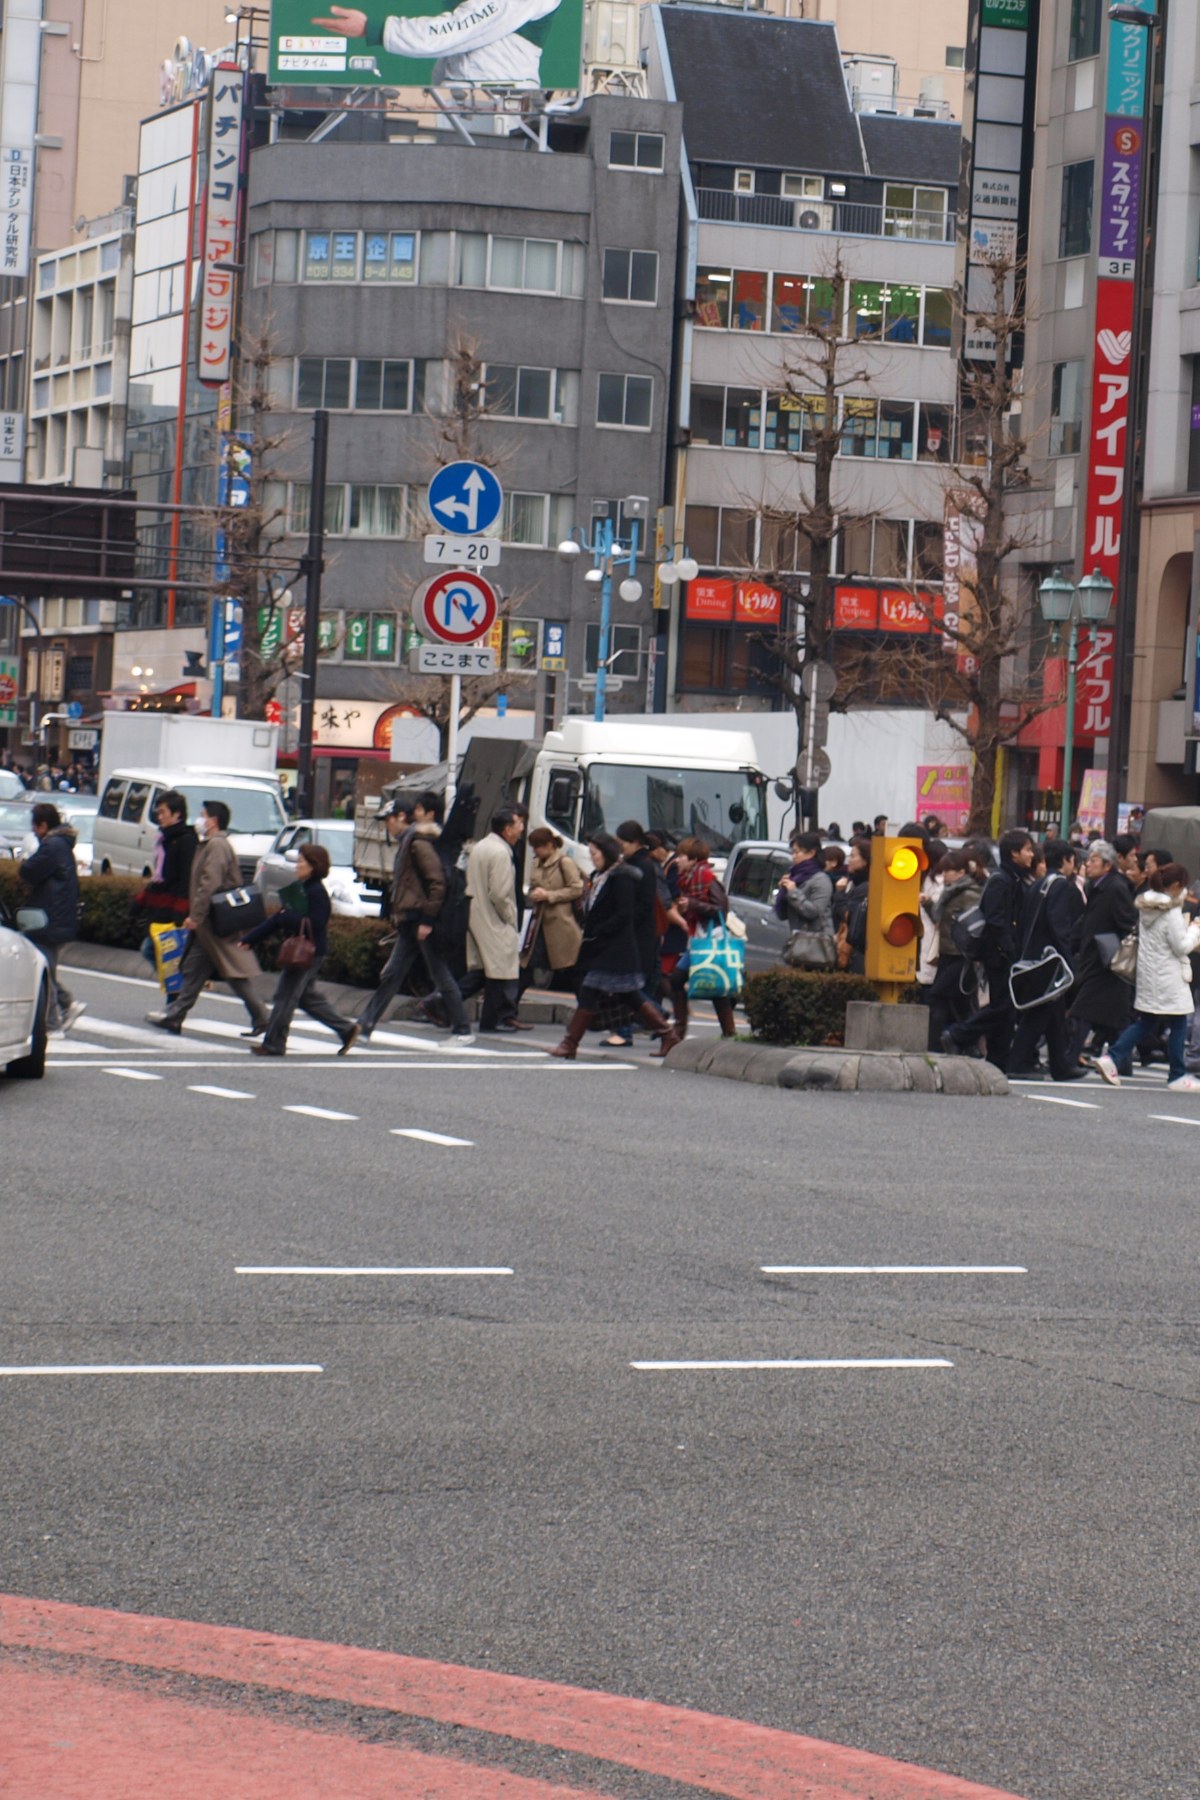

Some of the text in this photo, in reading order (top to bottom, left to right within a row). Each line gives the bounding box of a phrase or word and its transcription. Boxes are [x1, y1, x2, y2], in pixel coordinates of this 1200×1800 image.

[428, 2, 498, 37] NAVITIME
[281, 58, 328, 69] ナビタイム
[1116, 104, 1139, 115] 4F
[211, 82, 243, 202] パチンコ
[4, 164, 21, 268] 日本デジタル研究所
[1110, 161, 1131, 252] スタッフィ
[308, 235, 414, 263] 京王企画
[1109, 262, 1132, 274] 3F
[204, 237, 233, 367] アラジン
[1091, 374, 1130, 557] アイフル
[435, 542, 490, 561] 7-20
[696, 596, 728, 609] Dining
[424, 652, 490, 669] ここまで
[1083, 632, 1113, 731] アイフル
[313, 704, 361, 730] 味や
